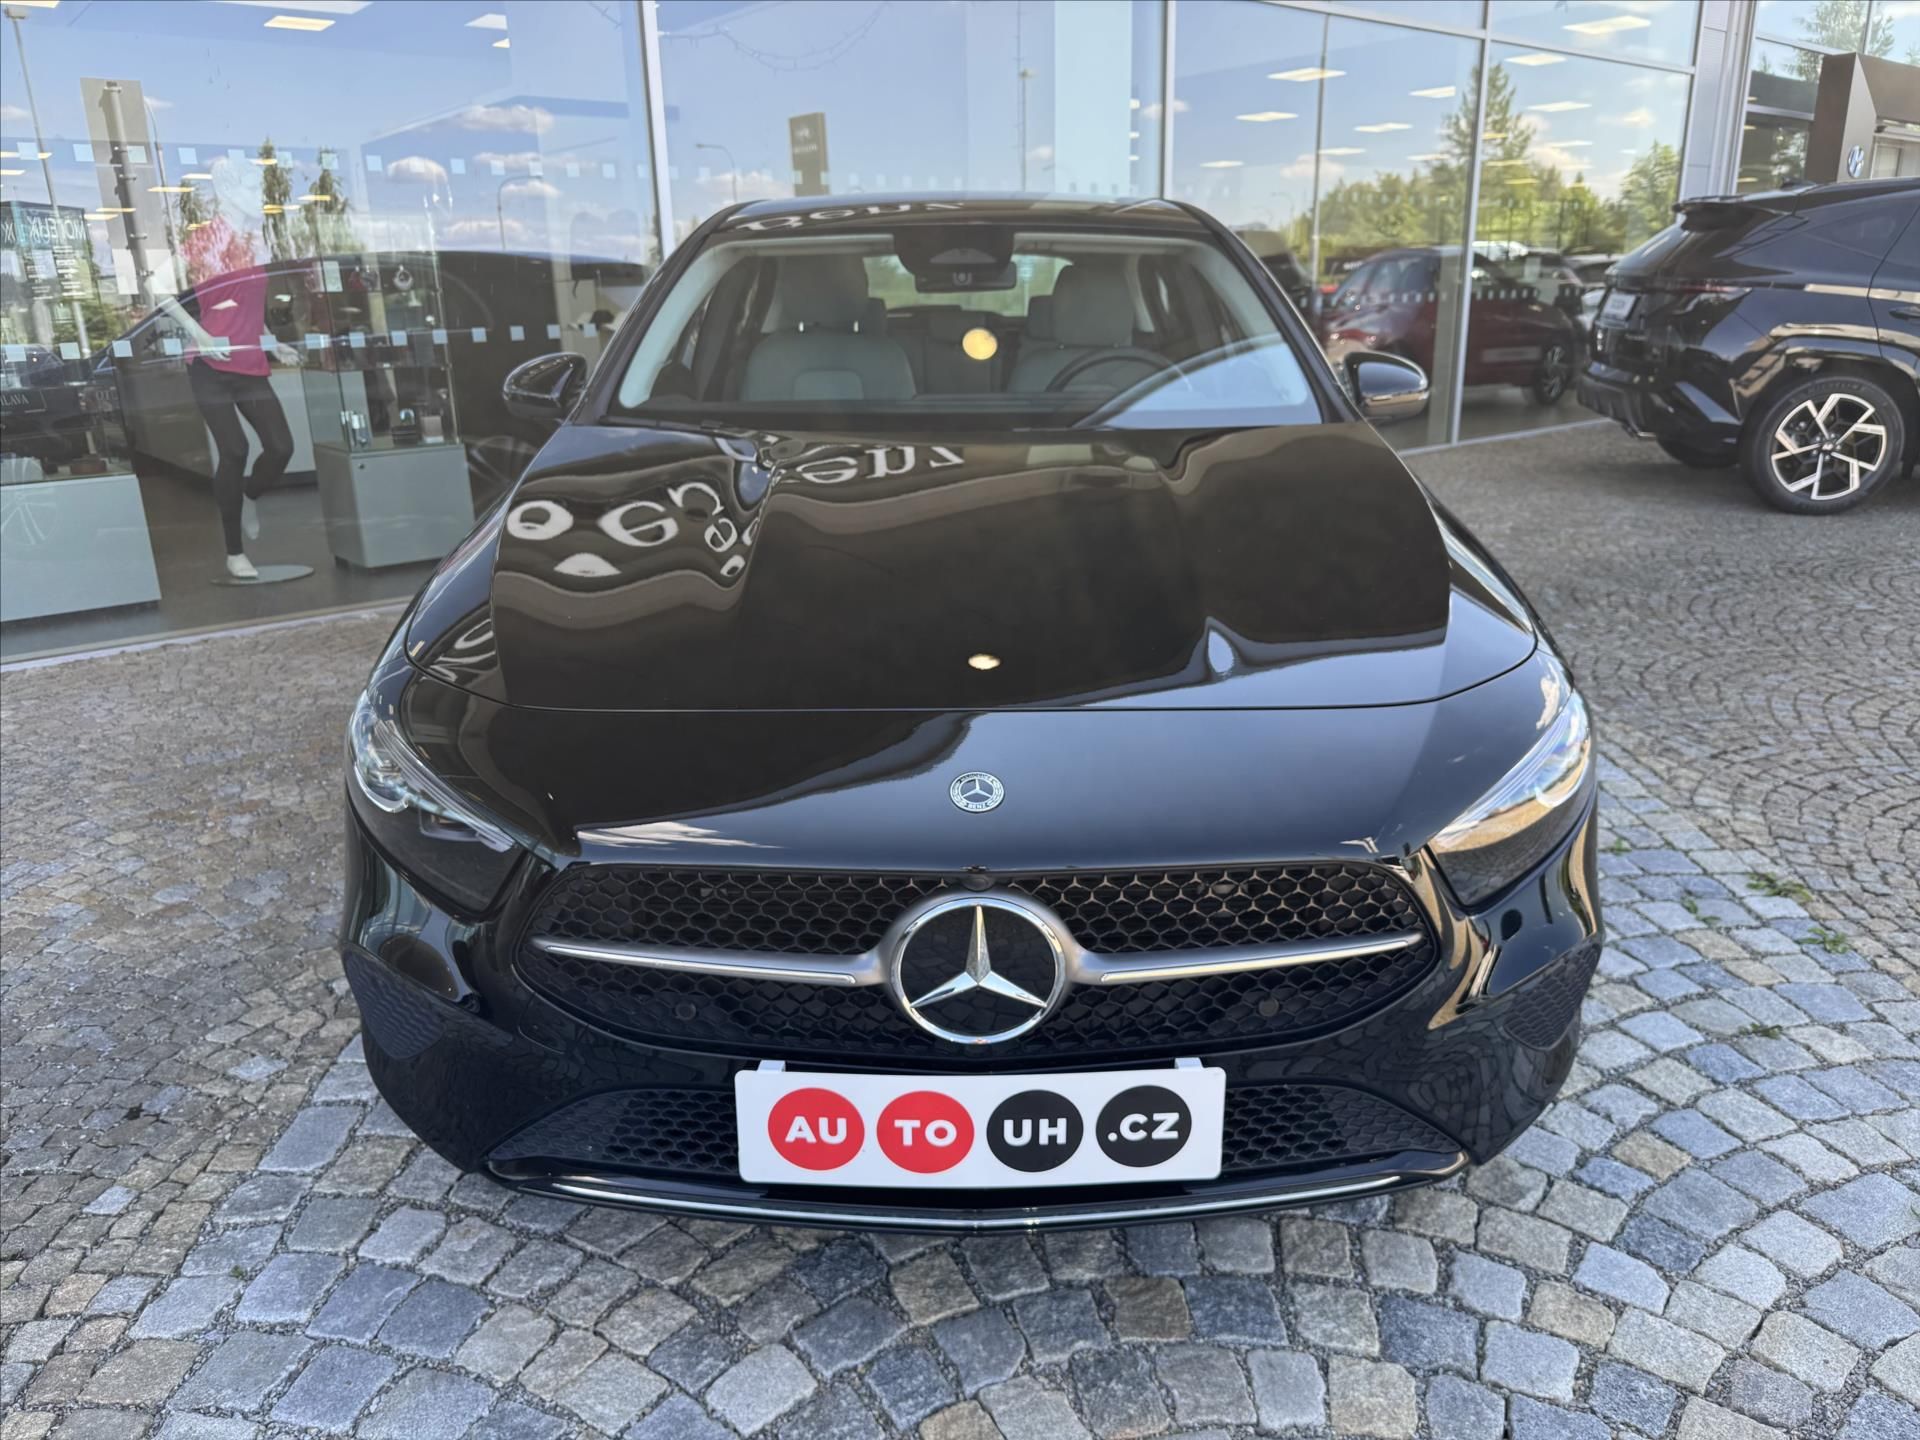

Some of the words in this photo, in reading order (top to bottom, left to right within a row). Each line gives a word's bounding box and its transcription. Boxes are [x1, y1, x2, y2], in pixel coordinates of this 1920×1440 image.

[784, 1115, 847, 1145] AU
[894, 1119, 958, 1147] TO
[1003, 1117, 1067, 1147] UH
[1107, 1112, 1180, 1142] .CZ
